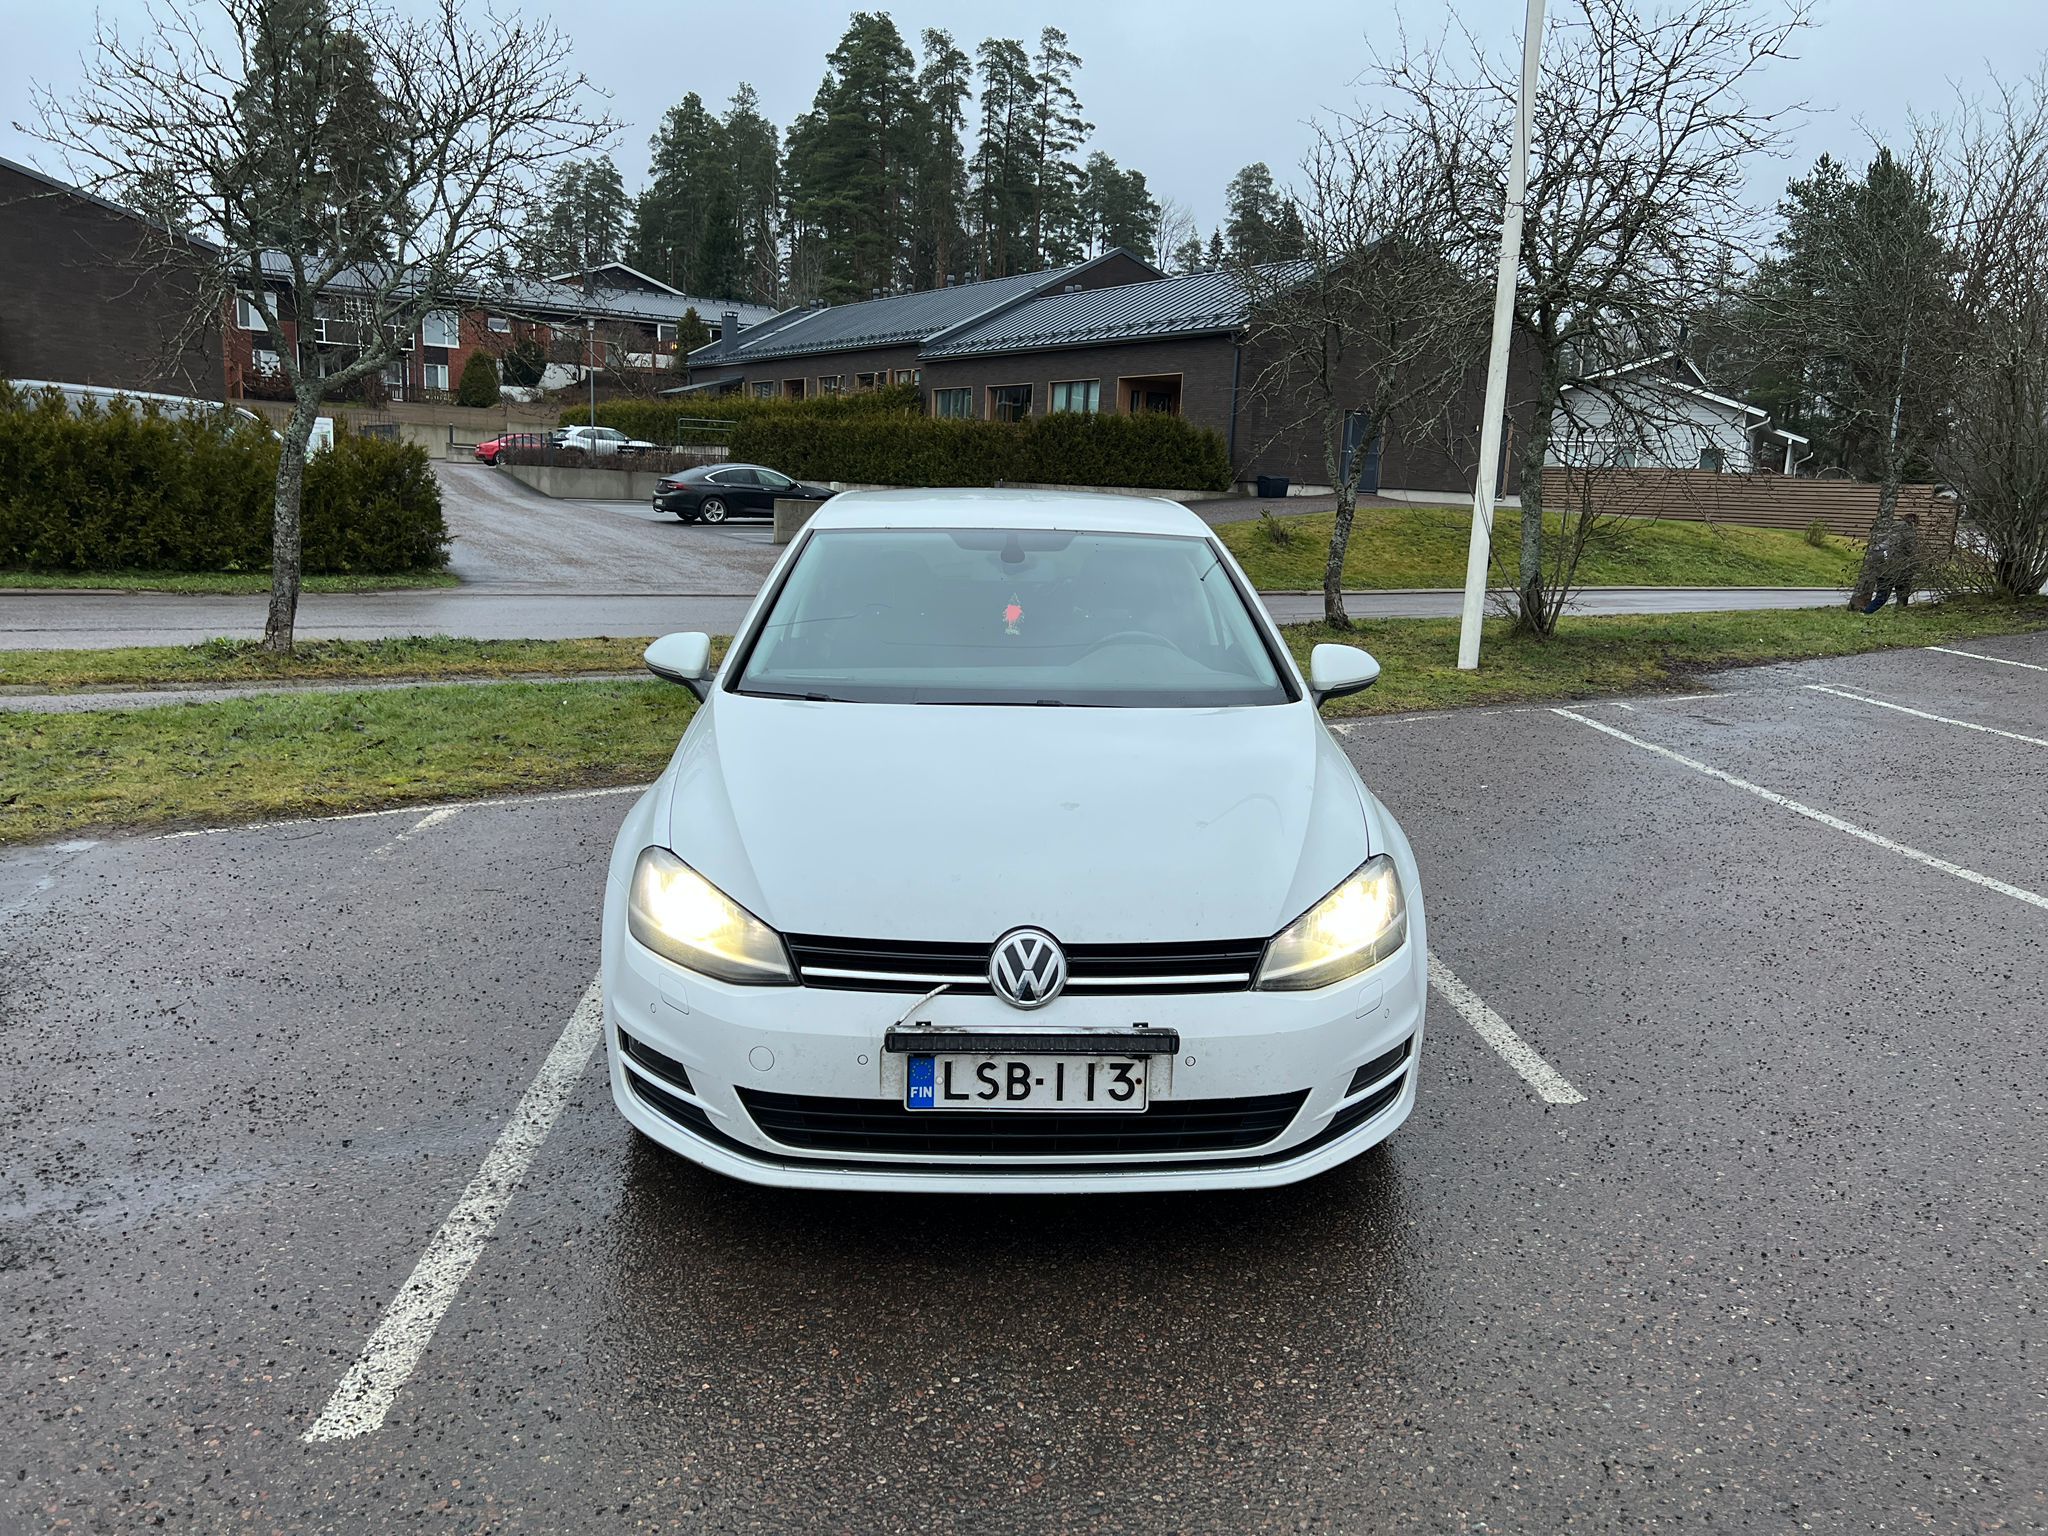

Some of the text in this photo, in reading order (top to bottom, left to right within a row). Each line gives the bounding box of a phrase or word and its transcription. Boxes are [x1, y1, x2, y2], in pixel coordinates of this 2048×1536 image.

[995, 935, 1061, 1001] VW
[910, 1086, 933, 1098] FIN
[943, 1061, 1136, 1102] LSB-113
